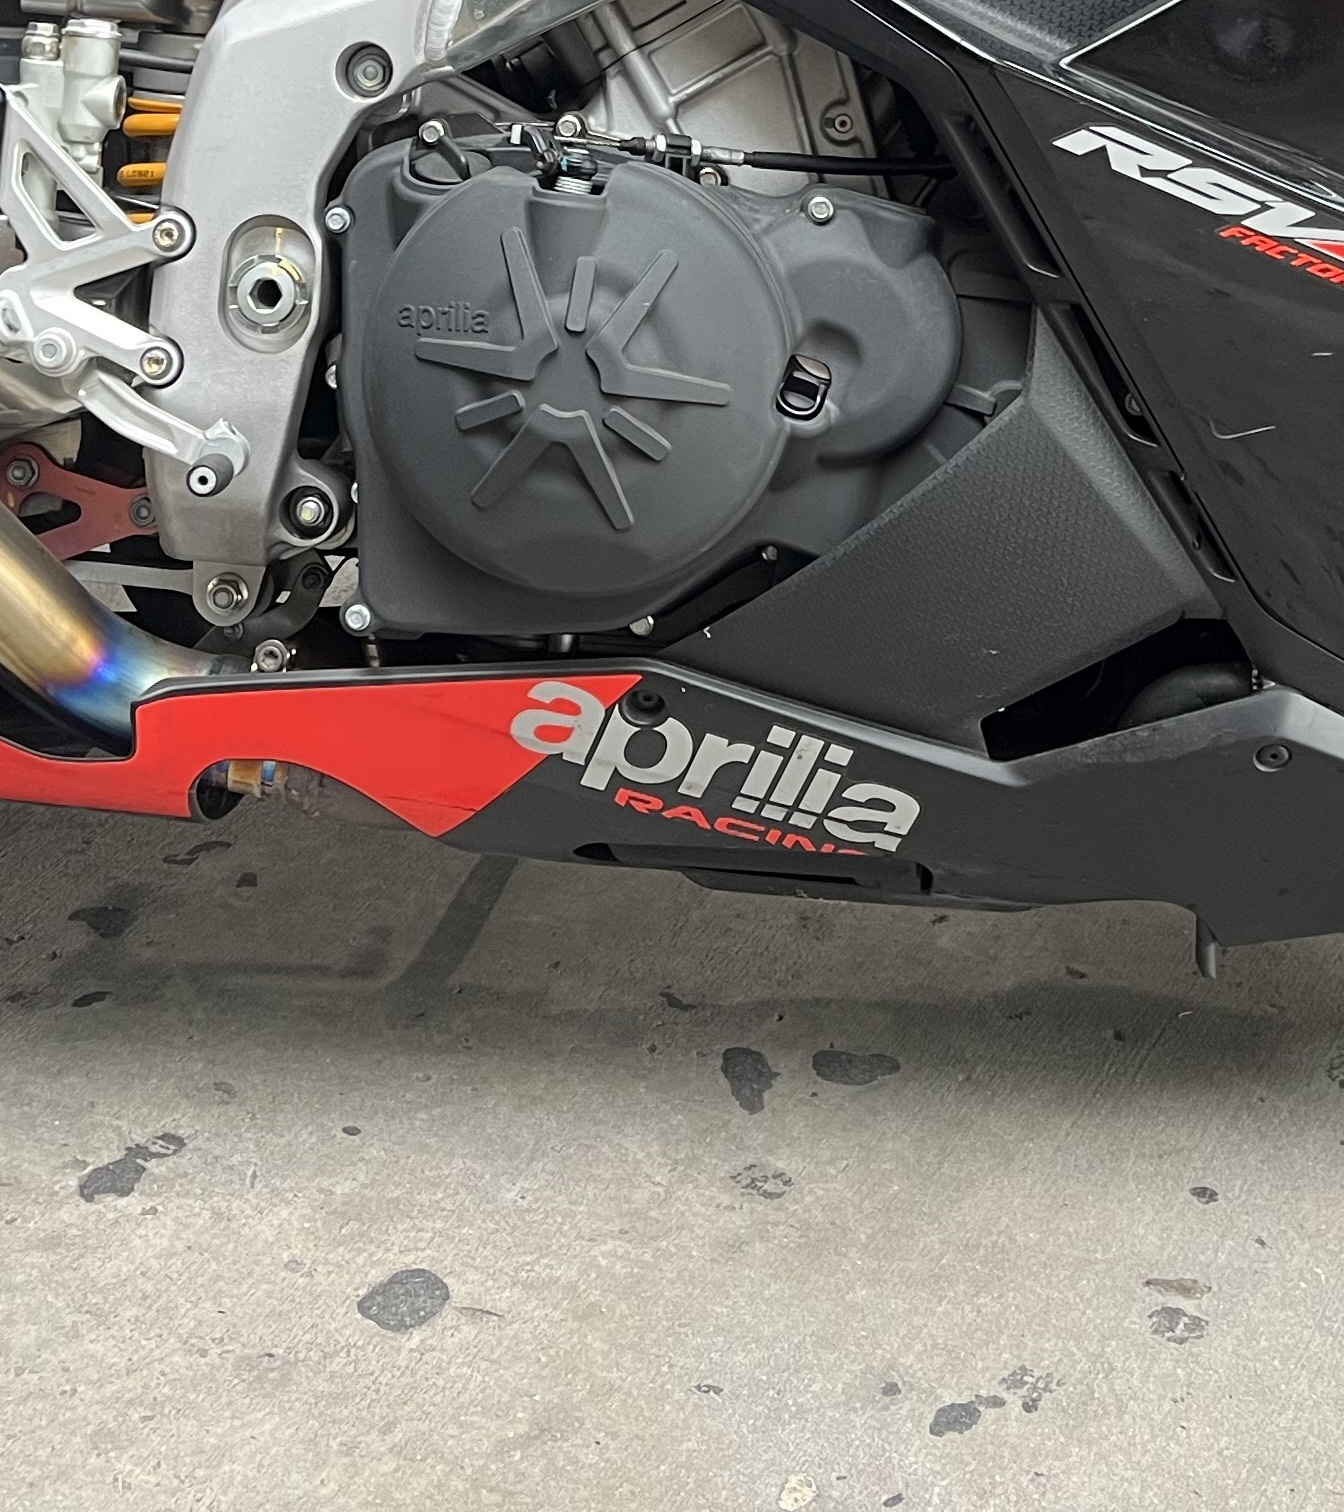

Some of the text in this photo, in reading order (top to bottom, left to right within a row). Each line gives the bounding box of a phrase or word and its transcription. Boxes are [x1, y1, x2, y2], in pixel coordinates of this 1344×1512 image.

[397, 300, 490, 337] aprilia
[509, 680, 922, 852] aprilia
[613, 787, 870, 856] RACIN
